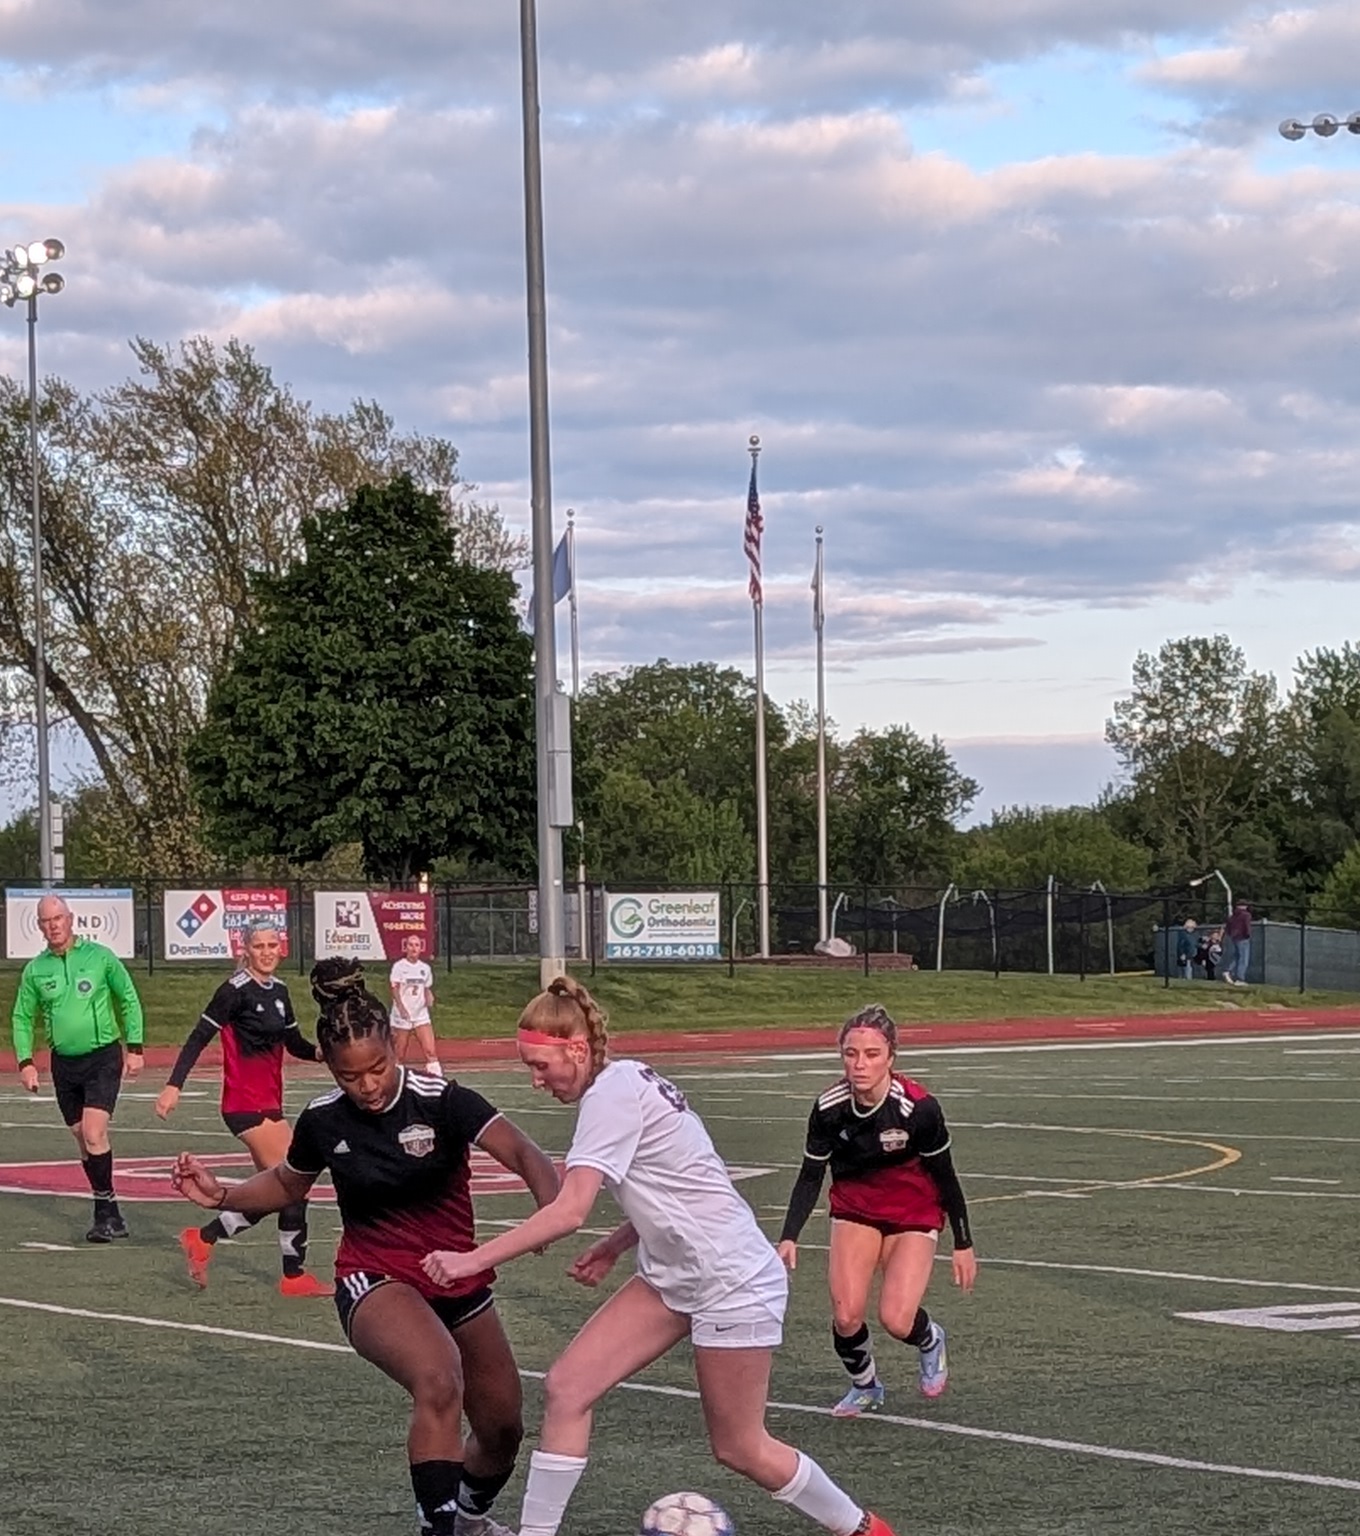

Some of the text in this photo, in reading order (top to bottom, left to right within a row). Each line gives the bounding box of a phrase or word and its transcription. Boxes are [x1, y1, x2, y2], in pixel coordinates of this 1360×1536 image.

[648, 898, 716, 914] Greenleaf
[647, 916, 716, 927] Orthodontics
[169, 943, 228, 955] Domino's
[613, 945, 715, 957] 262-758-6038
[412, 985, 419, 996] 2
